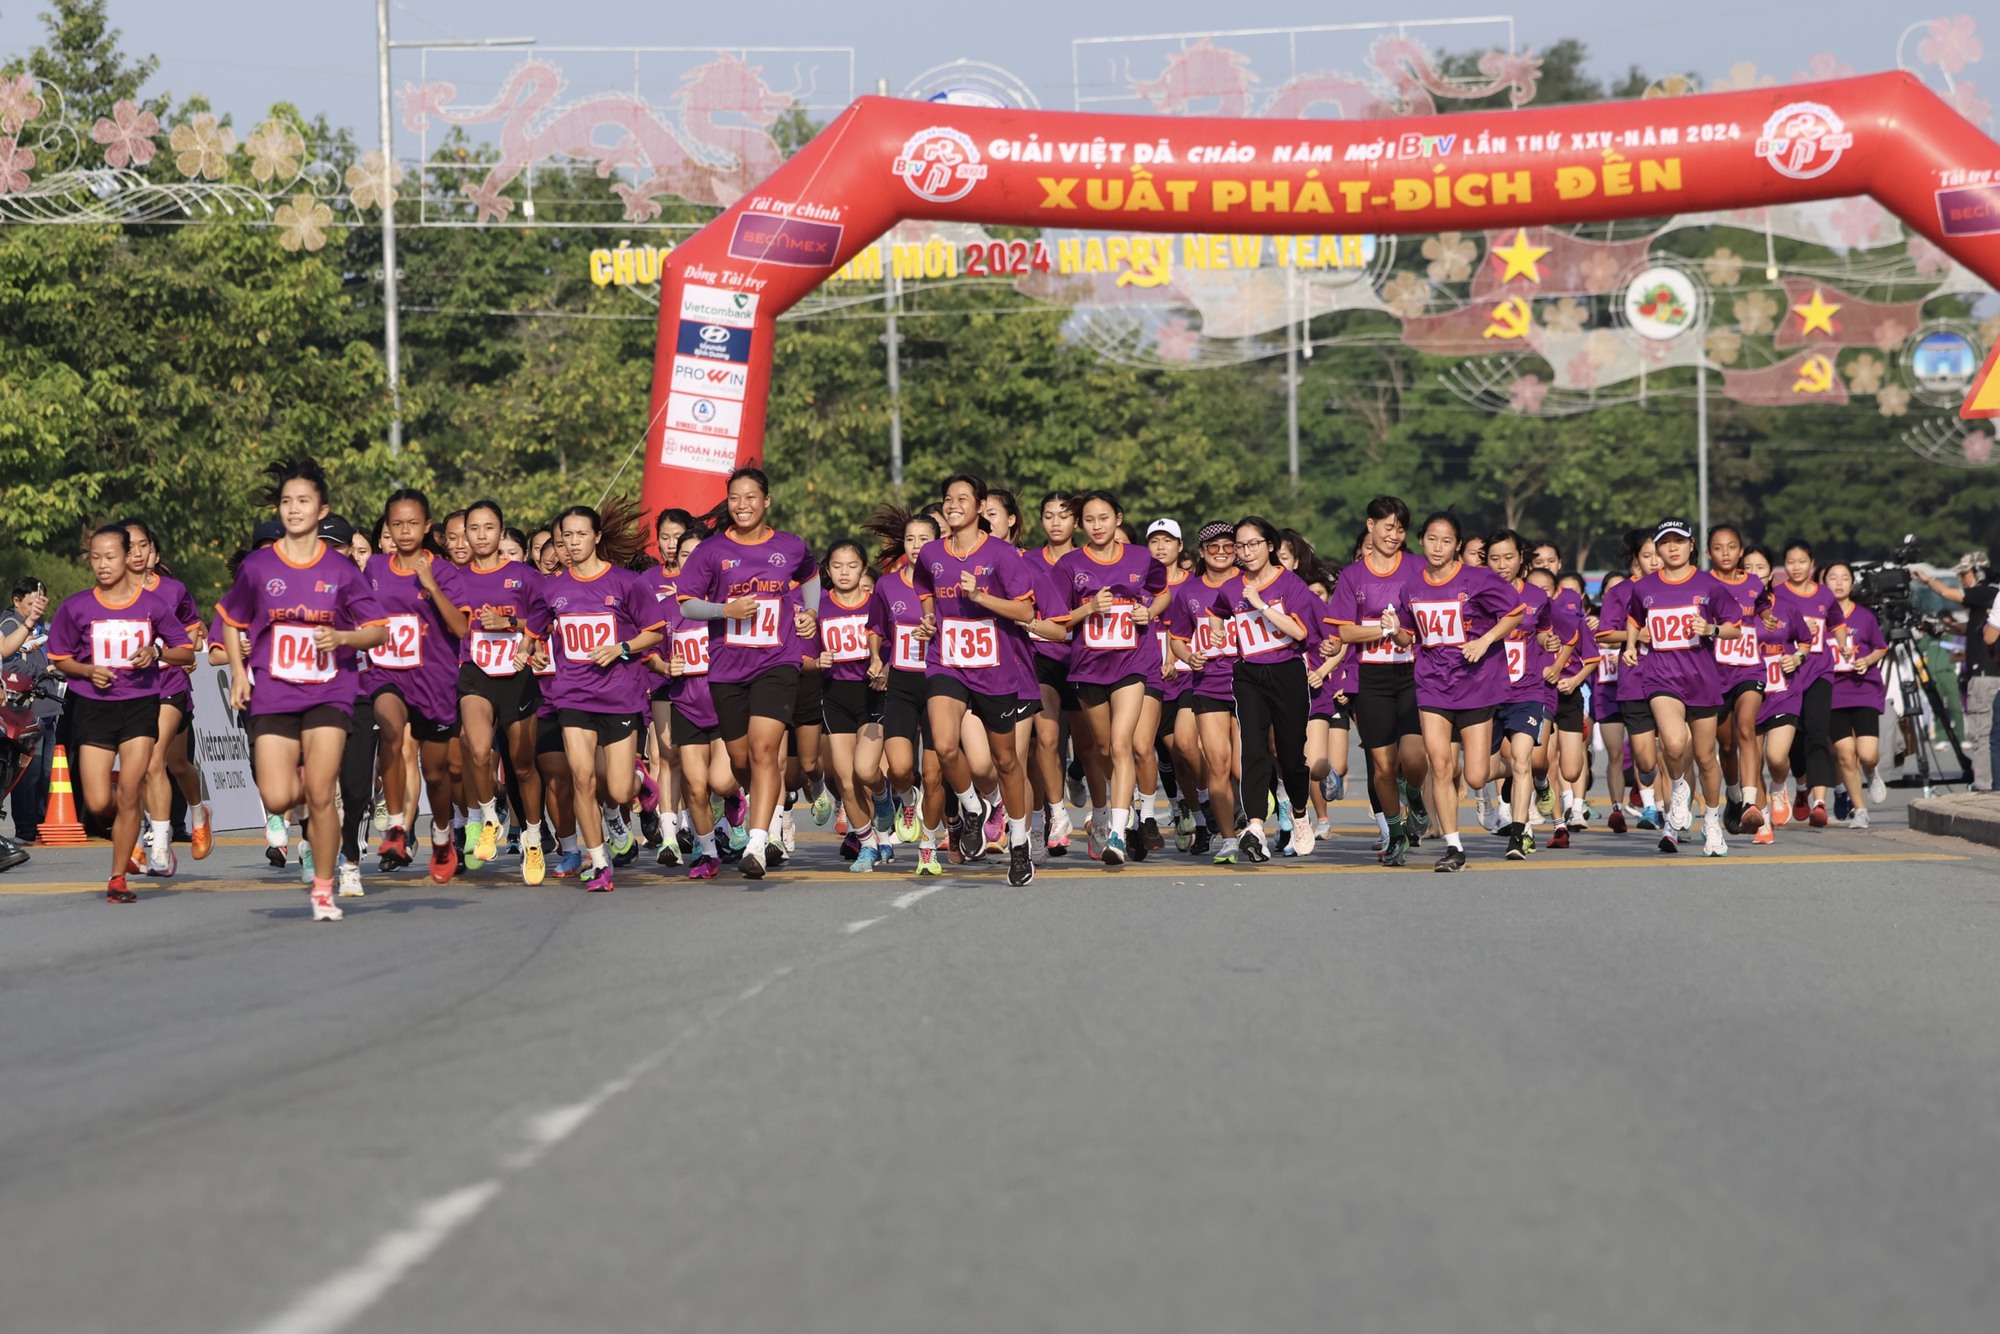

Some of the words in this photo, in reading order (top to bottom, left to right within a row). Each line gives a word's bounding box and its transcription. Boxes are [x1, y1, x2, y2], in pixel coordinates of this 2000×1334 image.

[988, 133, 1053, 163] GIẢI
[1058, 136, 1126, 170] VIỆT
[1272, 141, 1333, 163] NĂM
[1398, 133, 1457, 161] BTV
[1686, 123, 1741, 143] 2024
[892, 157, 926, 176] BTV
[1036, 163, 1199, 212] XUẤT
[1554, 147, 1683, 201] ĐẾN
[965, 239, 1052, 277] 2024
[1057, 235, 1175, 275] HAPPY
[1183, 233, 1263, 270] NEW
[1272, 235, 1367, 269] YEAR
[684, 301, 752, 319] Vietcombank
[722, 558, 741, 570] BTV
[974, 566, 994, 576] BTV
[314, 580, 338, 593] BTV
[504, 579, 523, 588] BTV
[1089, 611, 1132, 640] 076
[1416, 610, 1456, 638] 047
[1652, 614, 1694, 642] 028
[946, 628, 993, 658] 135
